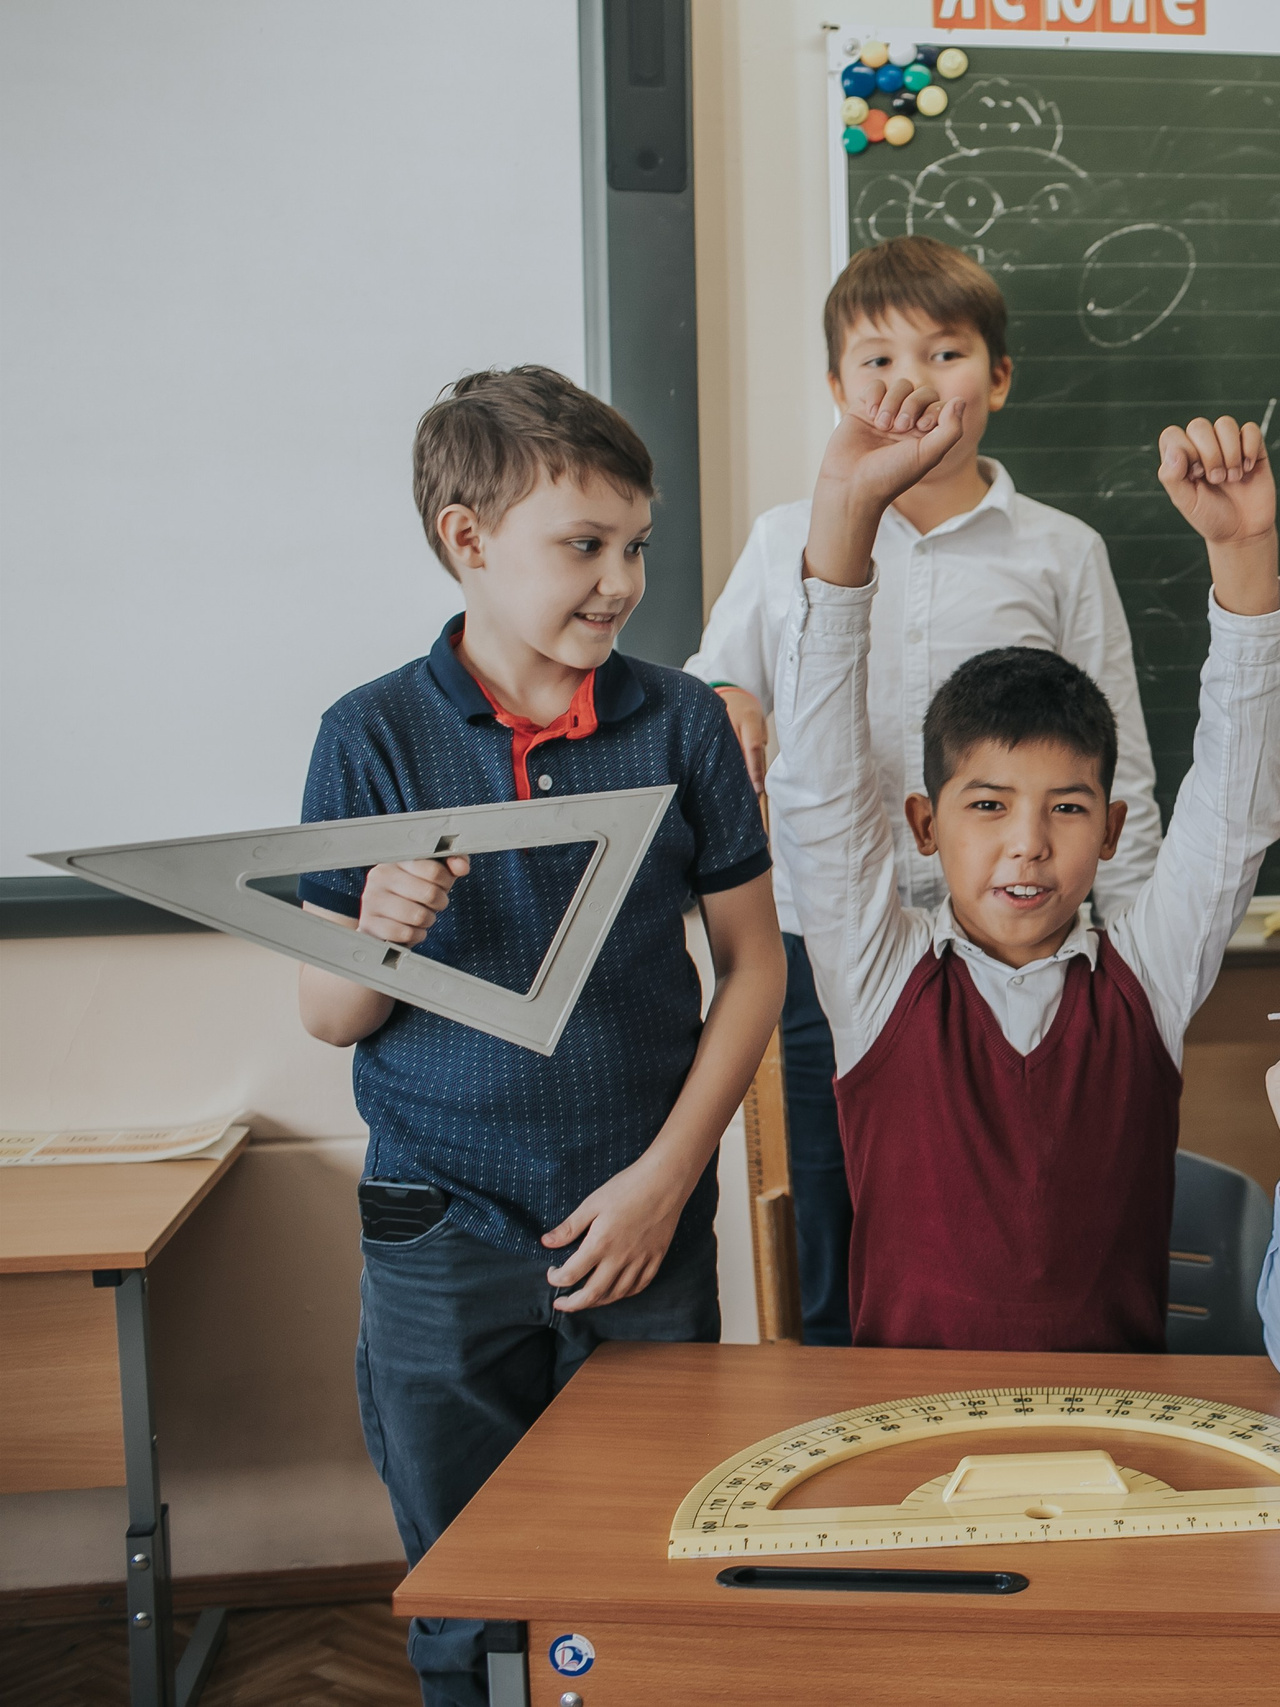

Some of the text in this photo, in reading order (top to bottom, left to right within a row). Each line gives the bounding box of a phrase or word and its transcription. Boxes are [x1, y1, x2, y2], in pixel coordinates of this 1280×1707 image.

[709, 1498, 727, 1511] 170
[726, 1477, 746, 1489] 160
[750, 1457, 773, 1469] 150
[783, 1440, 807, 1452] 140
[820, 1425, 847, 1436] 130
[864, 1414, 890, 1424] 120
[911, 1405, 936, 1414] 110
[959, 1399, 986, 1408] 100
[1207, 1412, 1228, 1420] 50
[1250, 1424, 1269, 1432] 40
[740, 1500, 757, 1510] 10
[754, 1481, 773, 1491] 20
[777, 1463, 796, 1473] 30
[807, 1448, 826, 1457] 40
[841, 1434, 861, 1443] 50
[880, 1423, 901, 1432] 60
[1105, 1408, 1130, 1416] 110
[1150, 1413, 1175, 1421] 120
[1191, 1420, 1216, 1429] 130
[1229, 1430, 1253, 1440] 140
